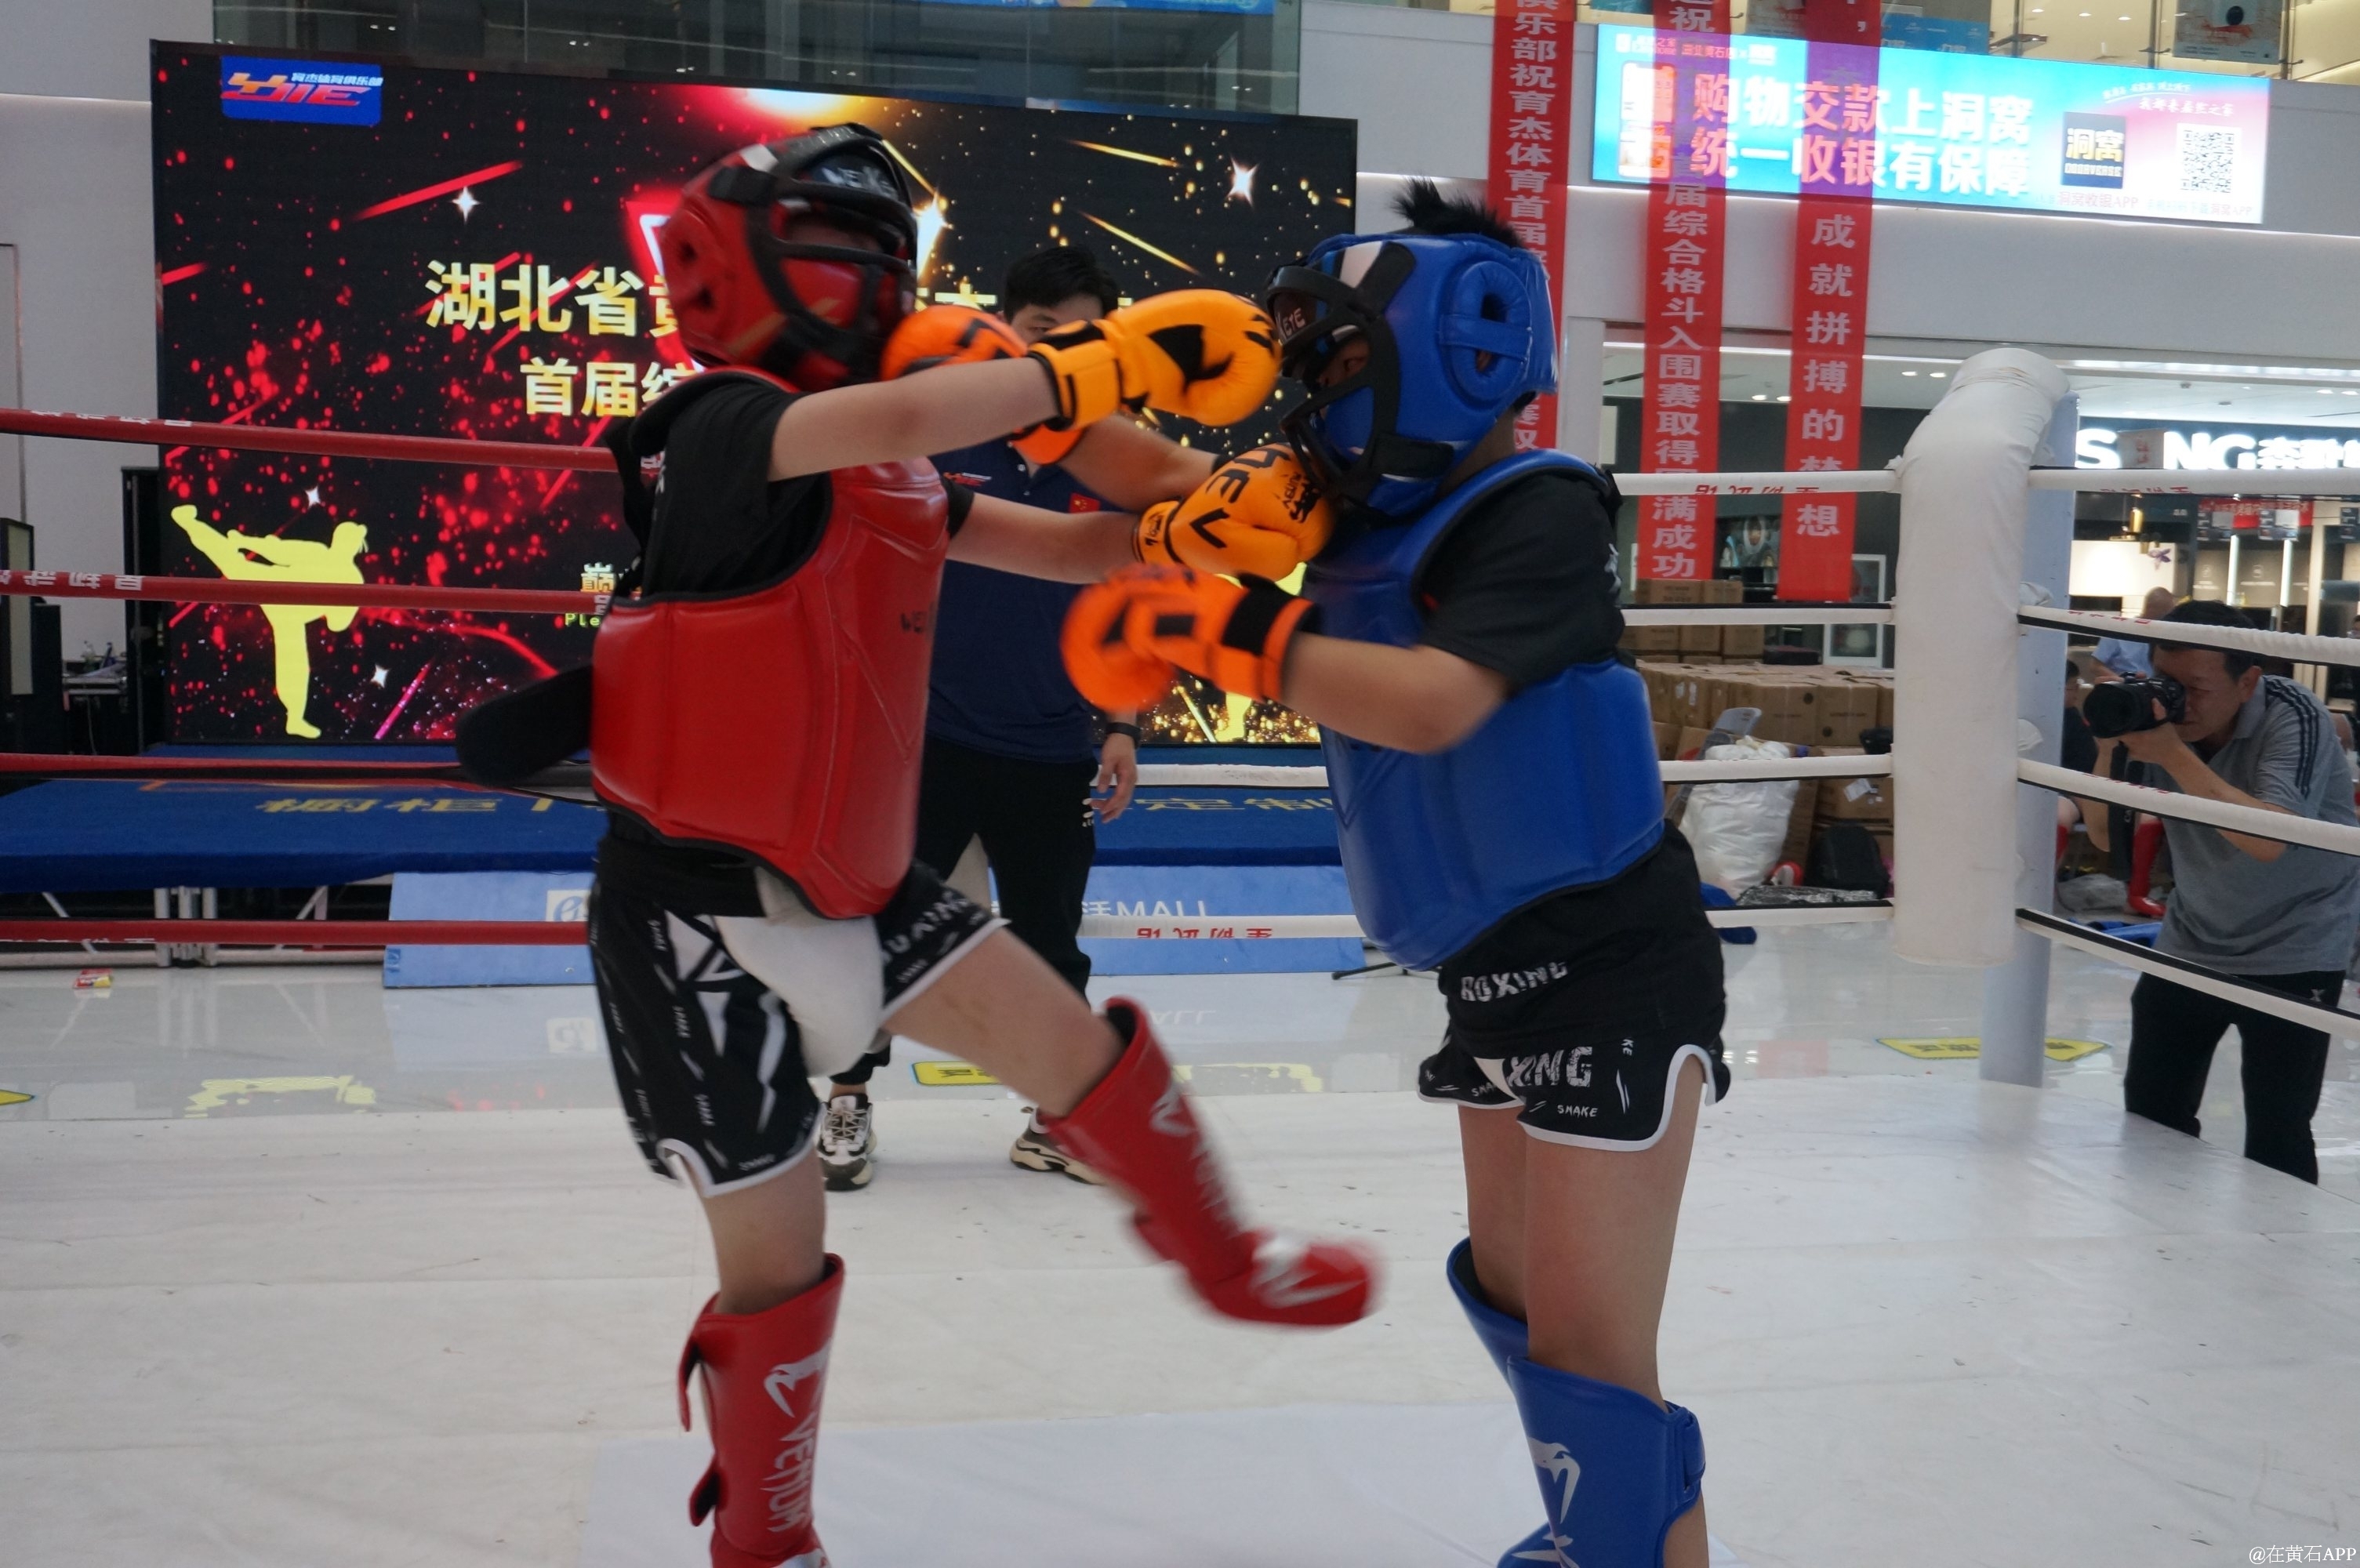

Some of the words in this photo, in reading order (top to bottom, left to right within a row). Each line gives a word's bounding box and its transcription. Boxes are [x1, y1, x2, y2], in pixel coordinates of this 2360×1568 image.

[1693, 74, 2034, 146] 购物交款上洞窝
[1689, 125, 2031, 198] 统一收银有保障
[2065, 127, 2126, 162] 洞窝
[2075, 427, 2257, 470] SNG
[581, 561, 630, 593] 巅
[565, 612, 601, 626] Ple
[1556, 1103, 1599, 1118] SNAKE
